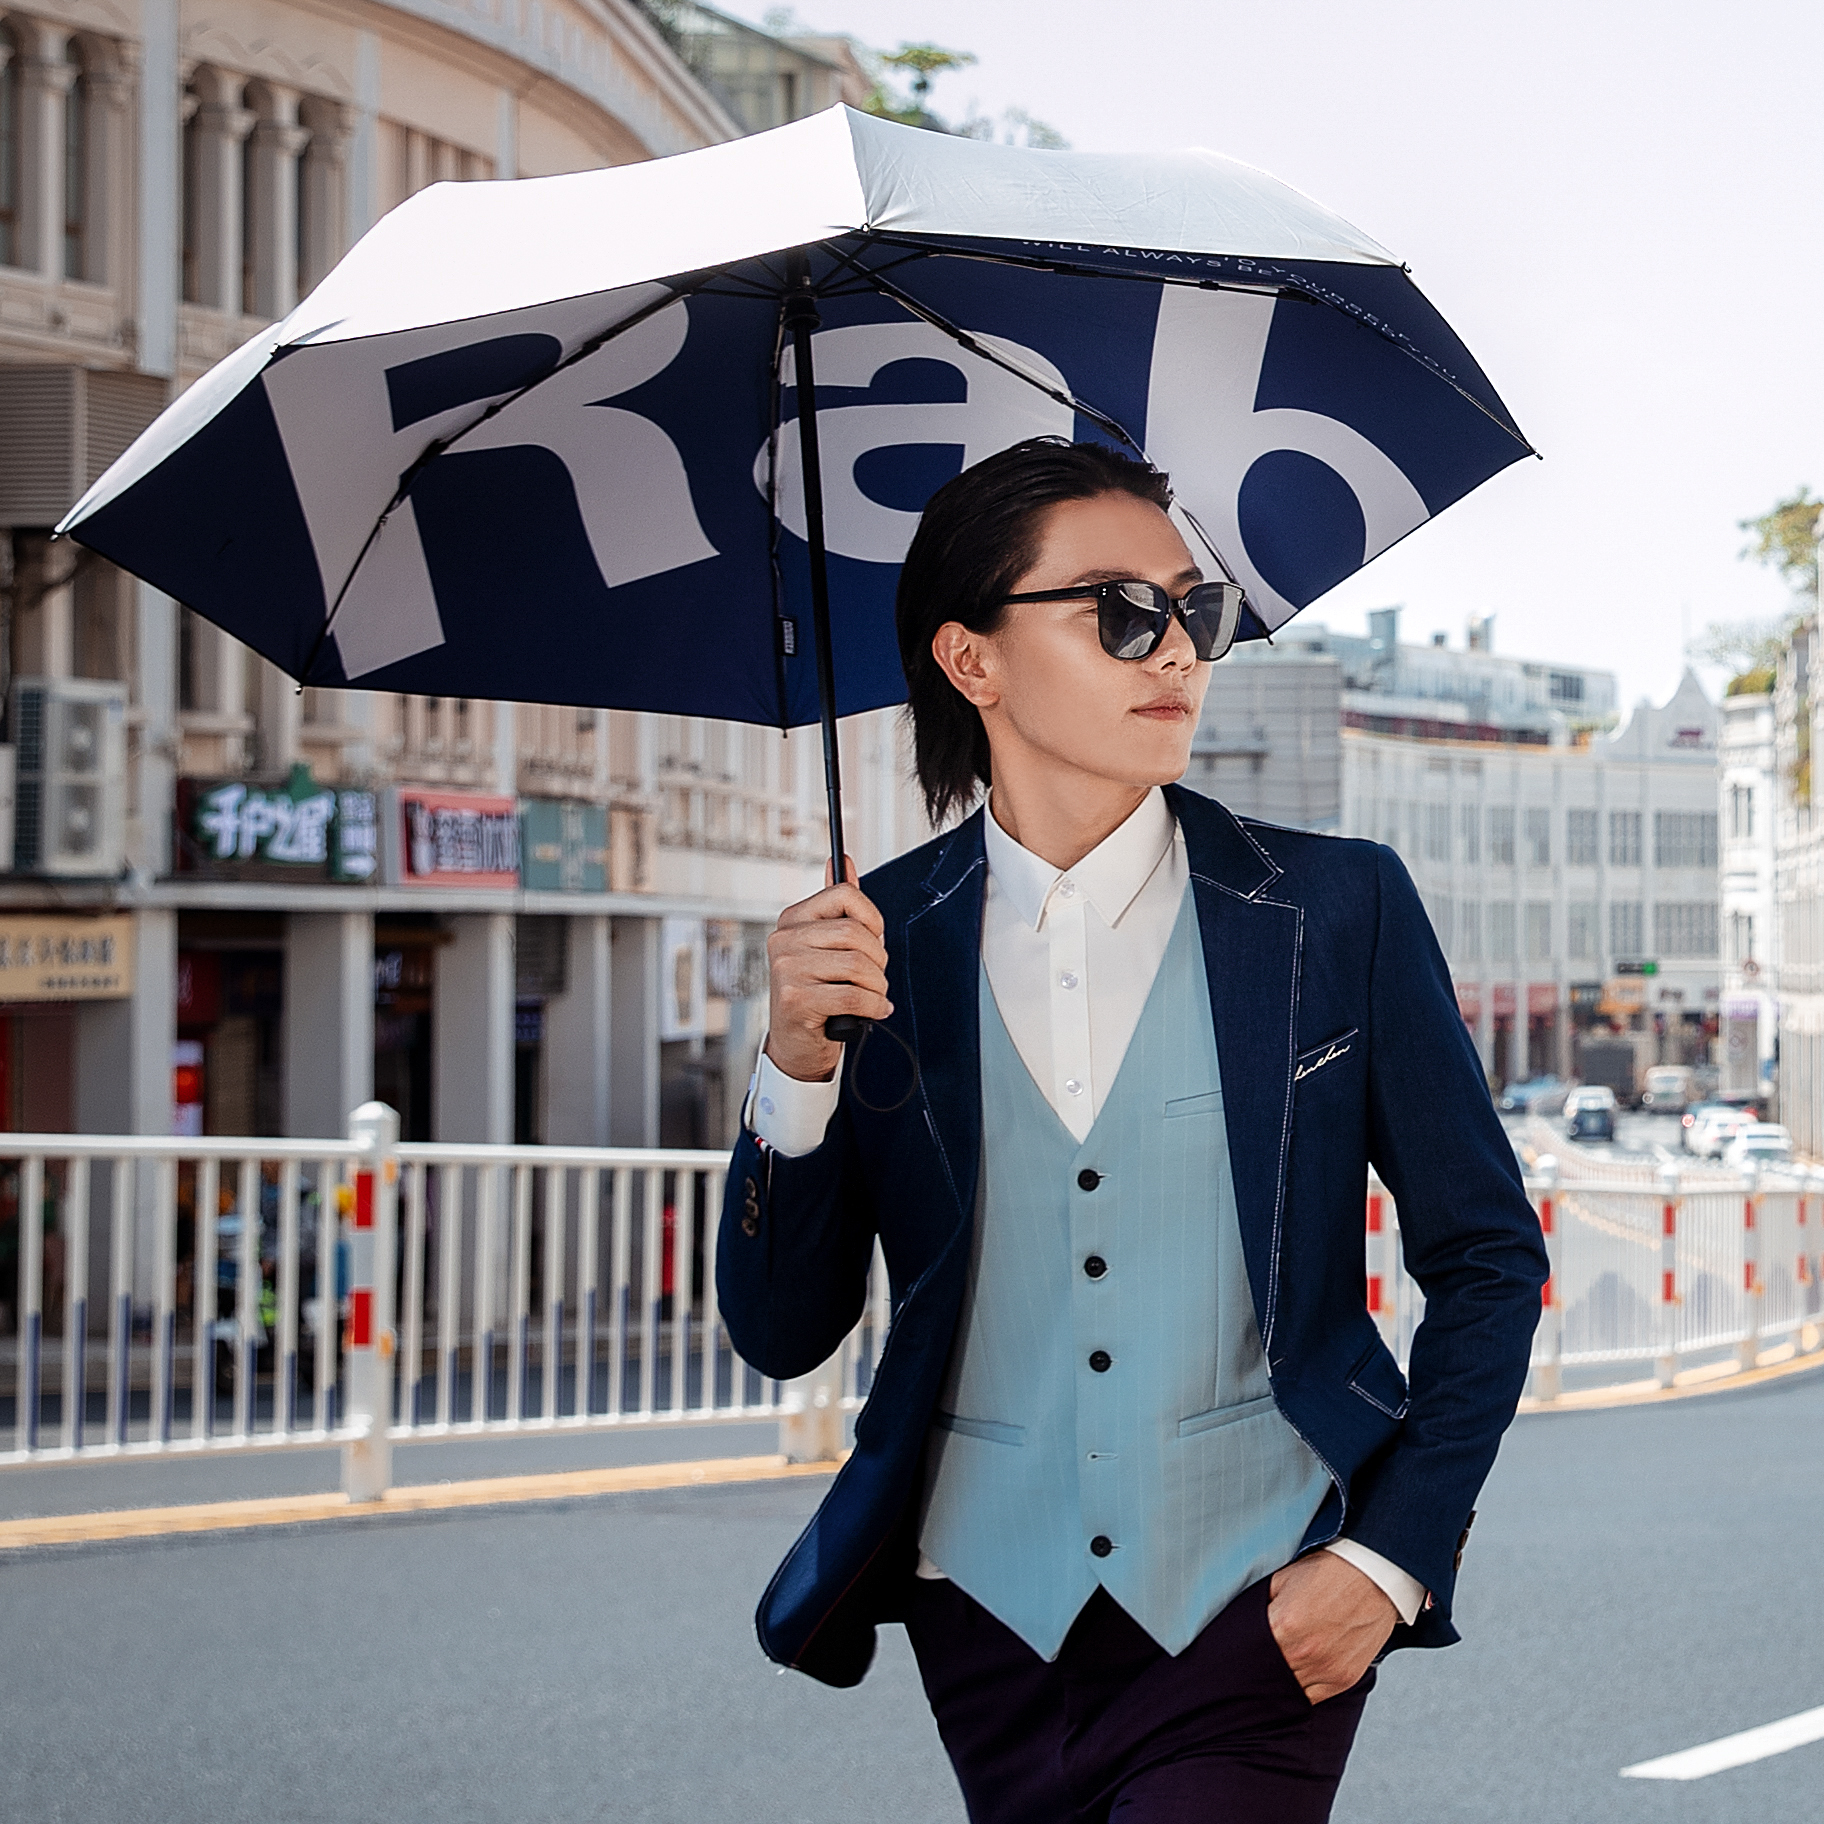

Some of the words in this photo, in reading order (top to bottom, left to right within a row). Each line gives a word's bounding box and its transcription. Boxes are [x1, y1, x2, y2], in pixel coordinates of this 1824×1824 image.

[1102, 246, 1222, 268] ALWAYS
[1237, 264, 1272, 277] BE
[1407, 343, 1457, 380] YOU
[262, 281, 1434, 680] Rab
